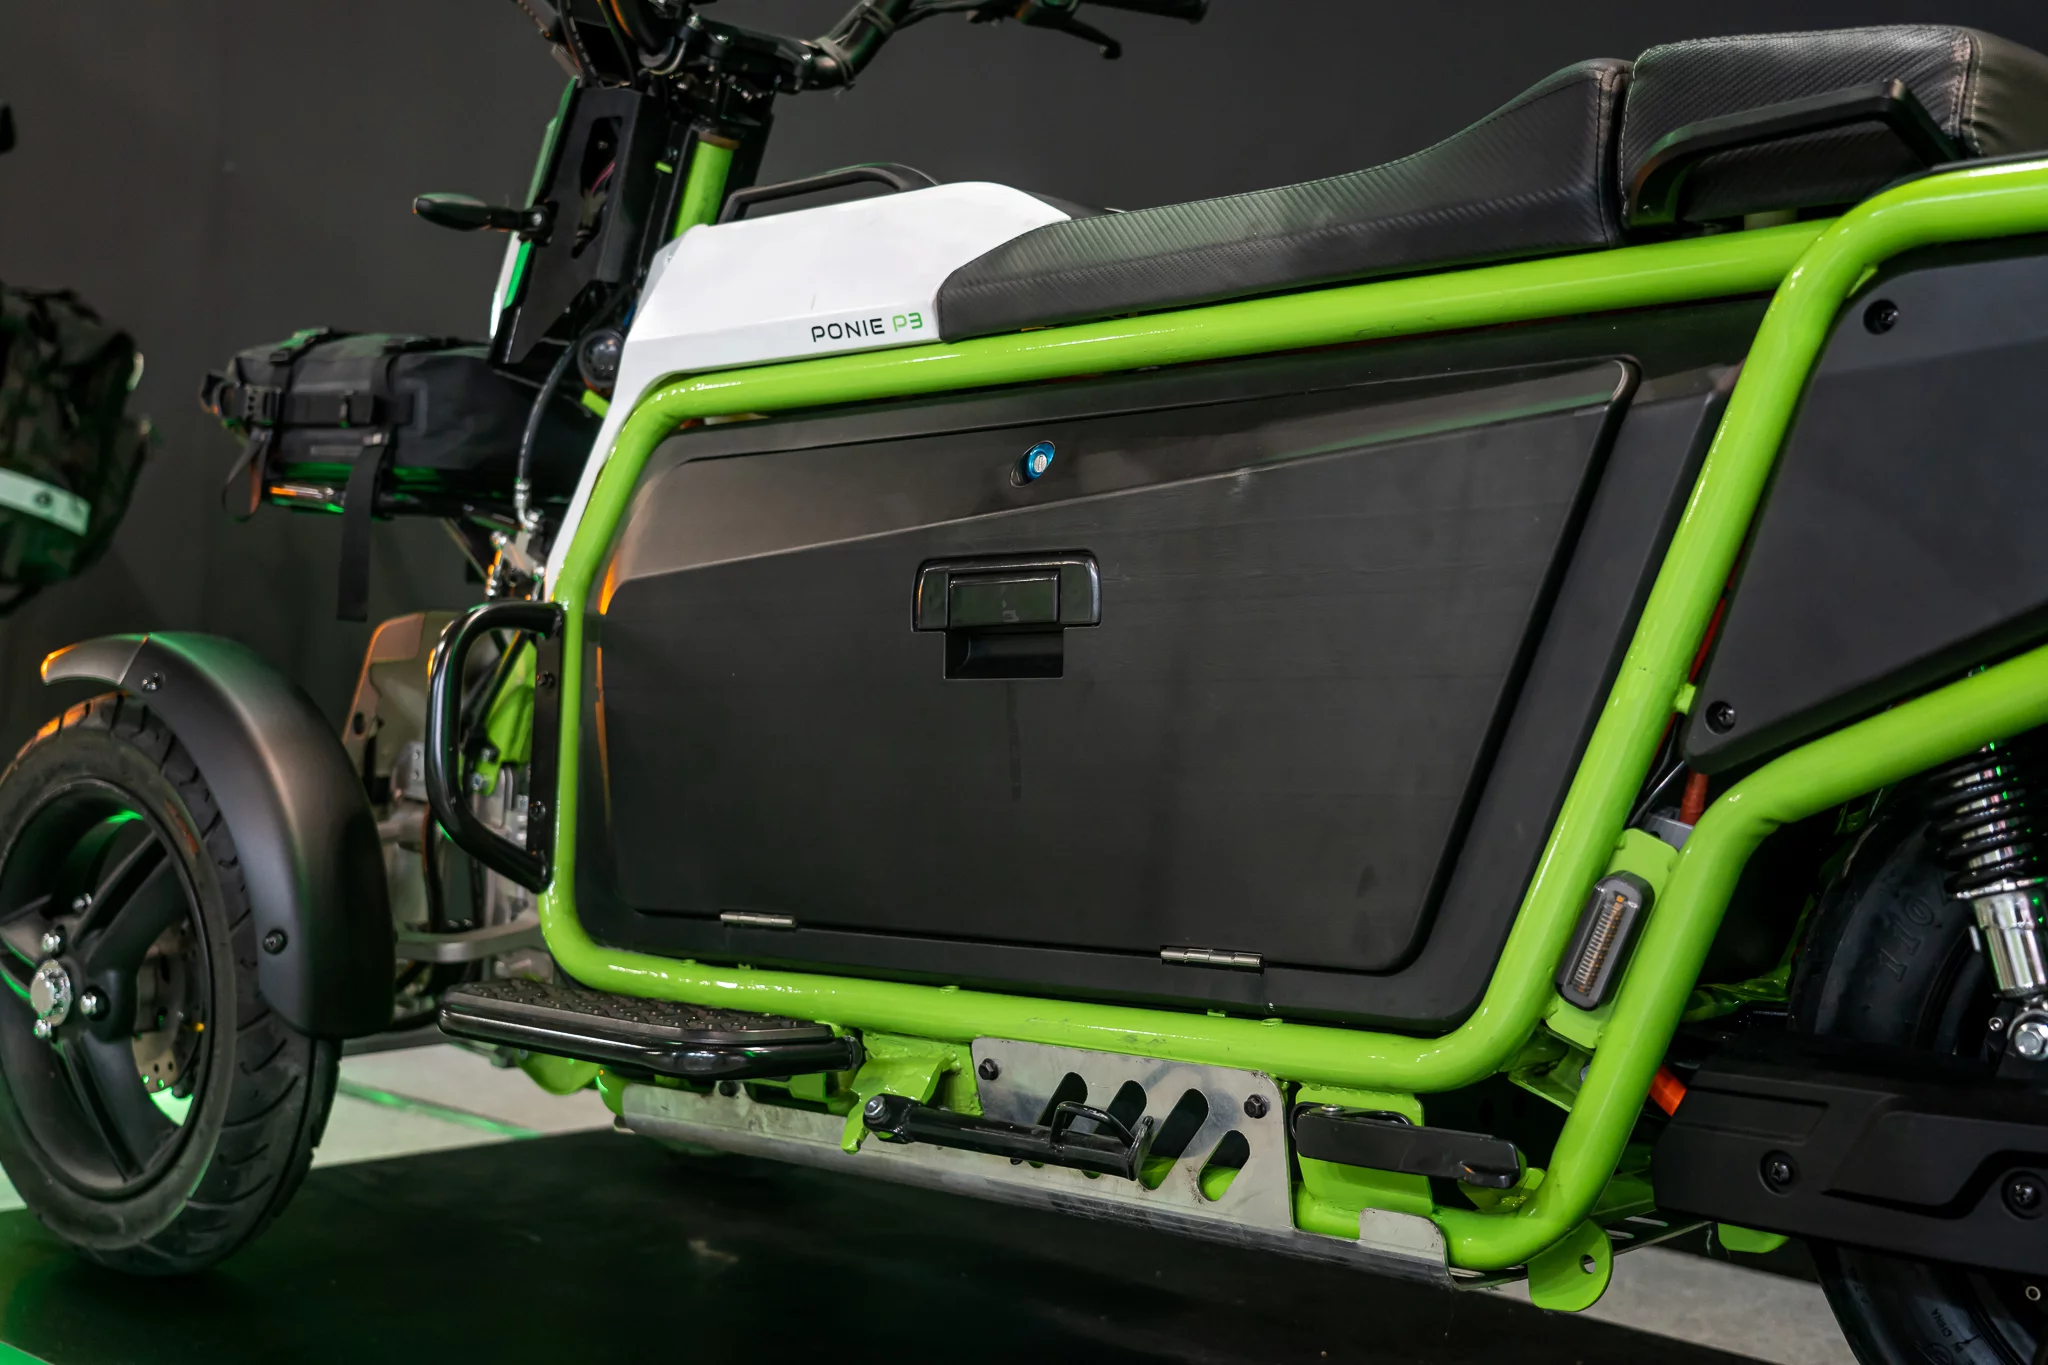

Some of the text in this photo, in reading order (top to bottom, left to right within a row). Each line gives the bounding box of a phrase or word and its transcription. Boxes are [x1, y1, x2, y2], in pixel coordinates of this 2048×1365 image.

[811, 312, 923, 342] PONIE P3
[1931, 1308, 1952, 1337] CHINA
